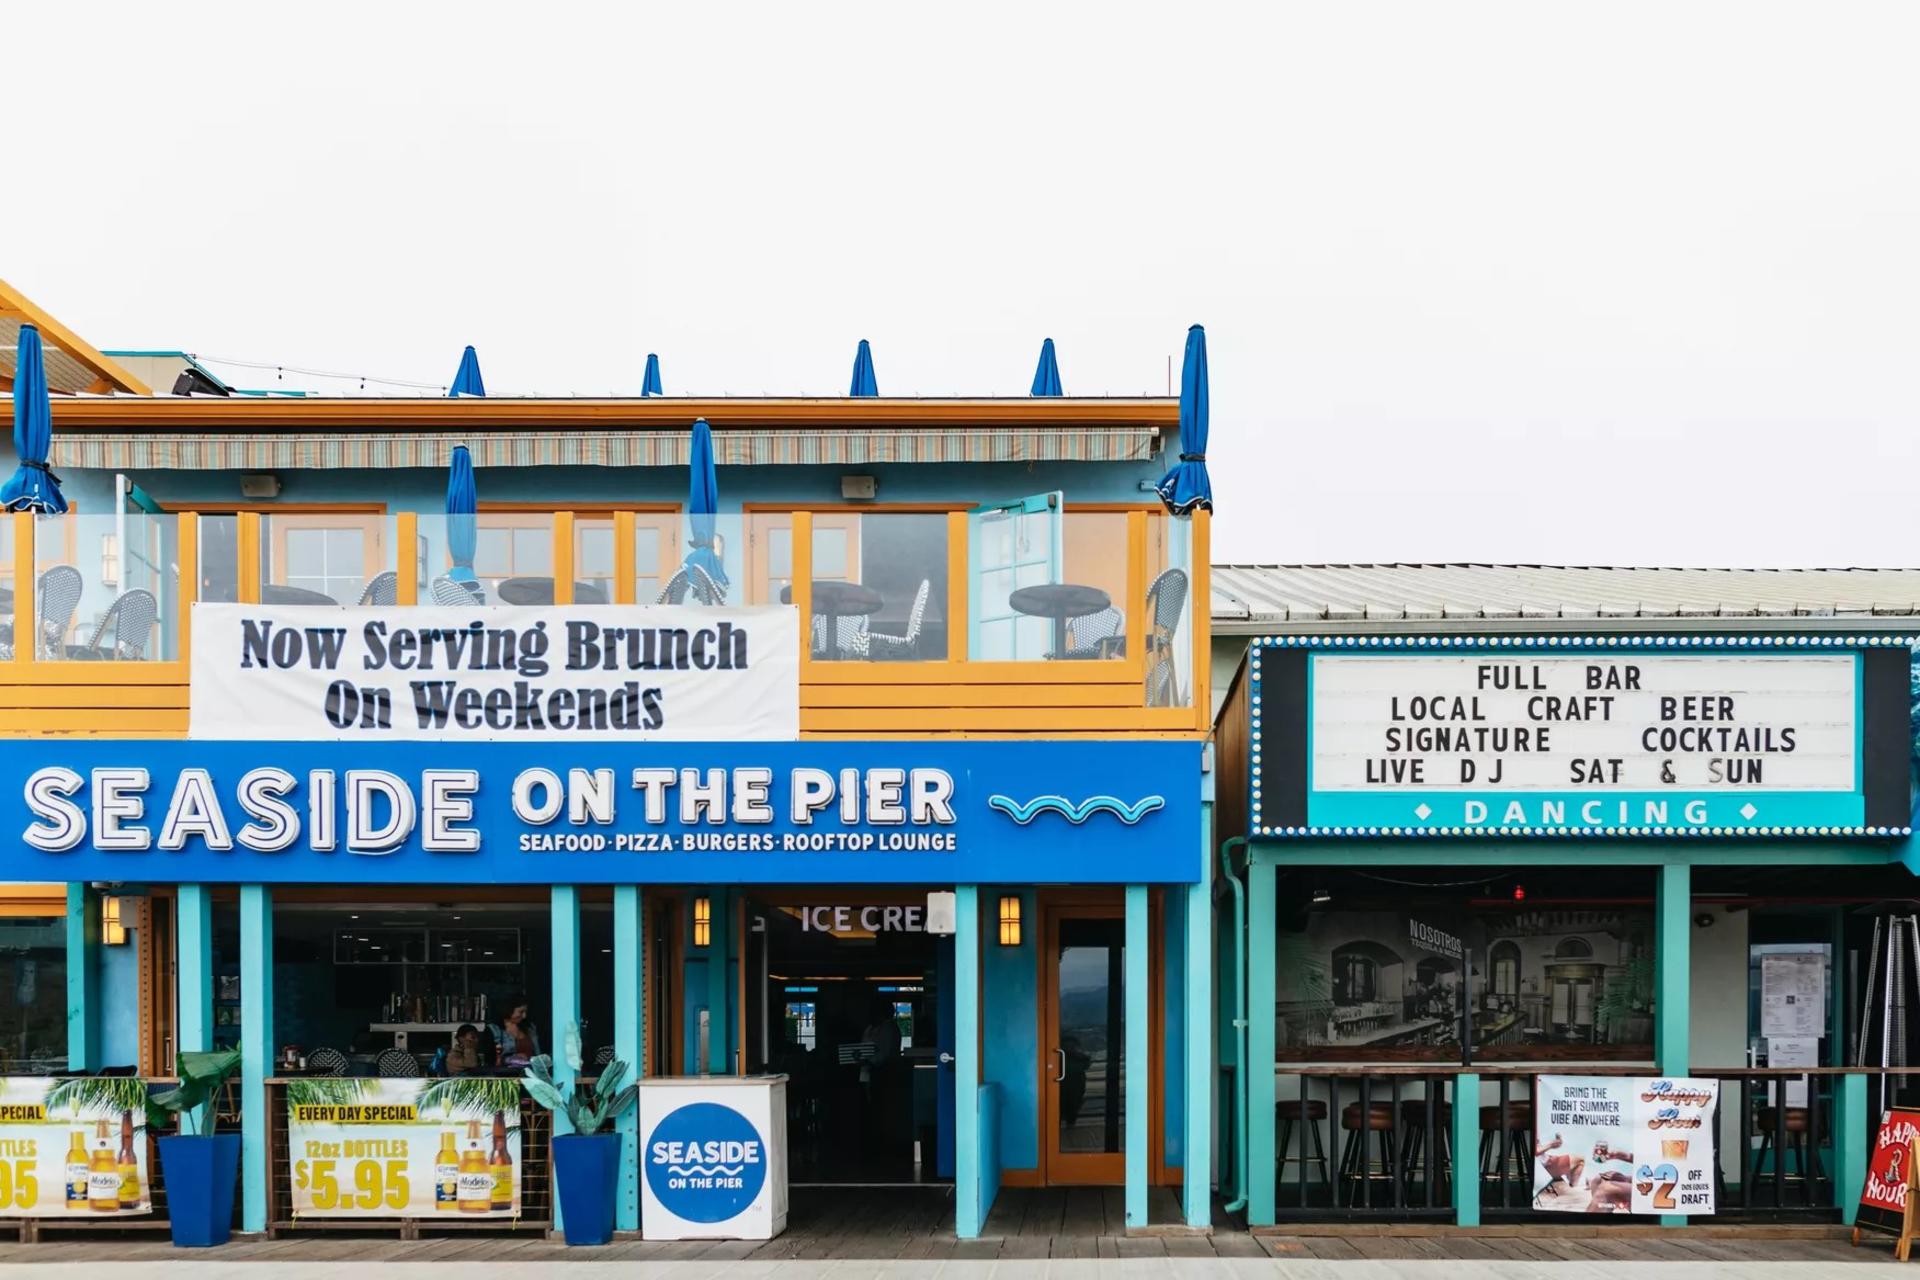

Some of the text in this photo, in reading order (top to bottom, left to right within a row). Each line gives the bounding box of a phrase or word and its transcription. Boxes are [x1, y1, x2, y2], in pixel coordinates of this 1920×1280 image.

[240, 619, 748, 677] Now Serving Brunch
[1477, 665, 1641, 690] FULL BAR
[324, 679, 664, 730] On Weekends
[1391, 696, 1735, 721] LOCAL CRAFT BEER
[1386, 727, 1796, 752] SIGNATURE COCKTAILS
[1366, 759, 1424, 783] LIVE
[1570, 758, 1624, 784] SAT
[1660, 759, 1676, 784] &
[1708, 758, 1762, 784] SUN
[22, 766, 957, 855] SEASIDE ON THE PIER
[1464, 801, 1708, 825] DANCING
[783, 834, 874, 850] ROOFTOP
[879, 834, 956, 850] LOUNGE
[802, 906, 852, 932] ICE
[1409, 919, 1462, 952] NOSOTROS
[1564, 1087, 1607, 1099] BRING THE
[1641, 1080, 1712, 1108] Happy
[0, 1106, 43, 1119] PECIAL
[298, 1106, 414, 1120] EVERY DAY SPECIAL
[1552, 1100, 1620, 1113] RIGHT SUMMER
[1572, 1114, 1620, 1126] ANYWHERE
[305, 1139, 408, 1157] 12oz BOTTLES
[652, 1141, 759, 1164] SEASIDE
[295, 1159, 410, 1210] $5.95
[668, 1178, 743, 1189] ON THE PIER
[1636, 1163, 1679, 1209] $2
[1688, 1169, 1702, 1180] OFF
[1681, 1193, 1710, 1204] DRAFT
[1866, 1171, 1908, 1207] HOUR
